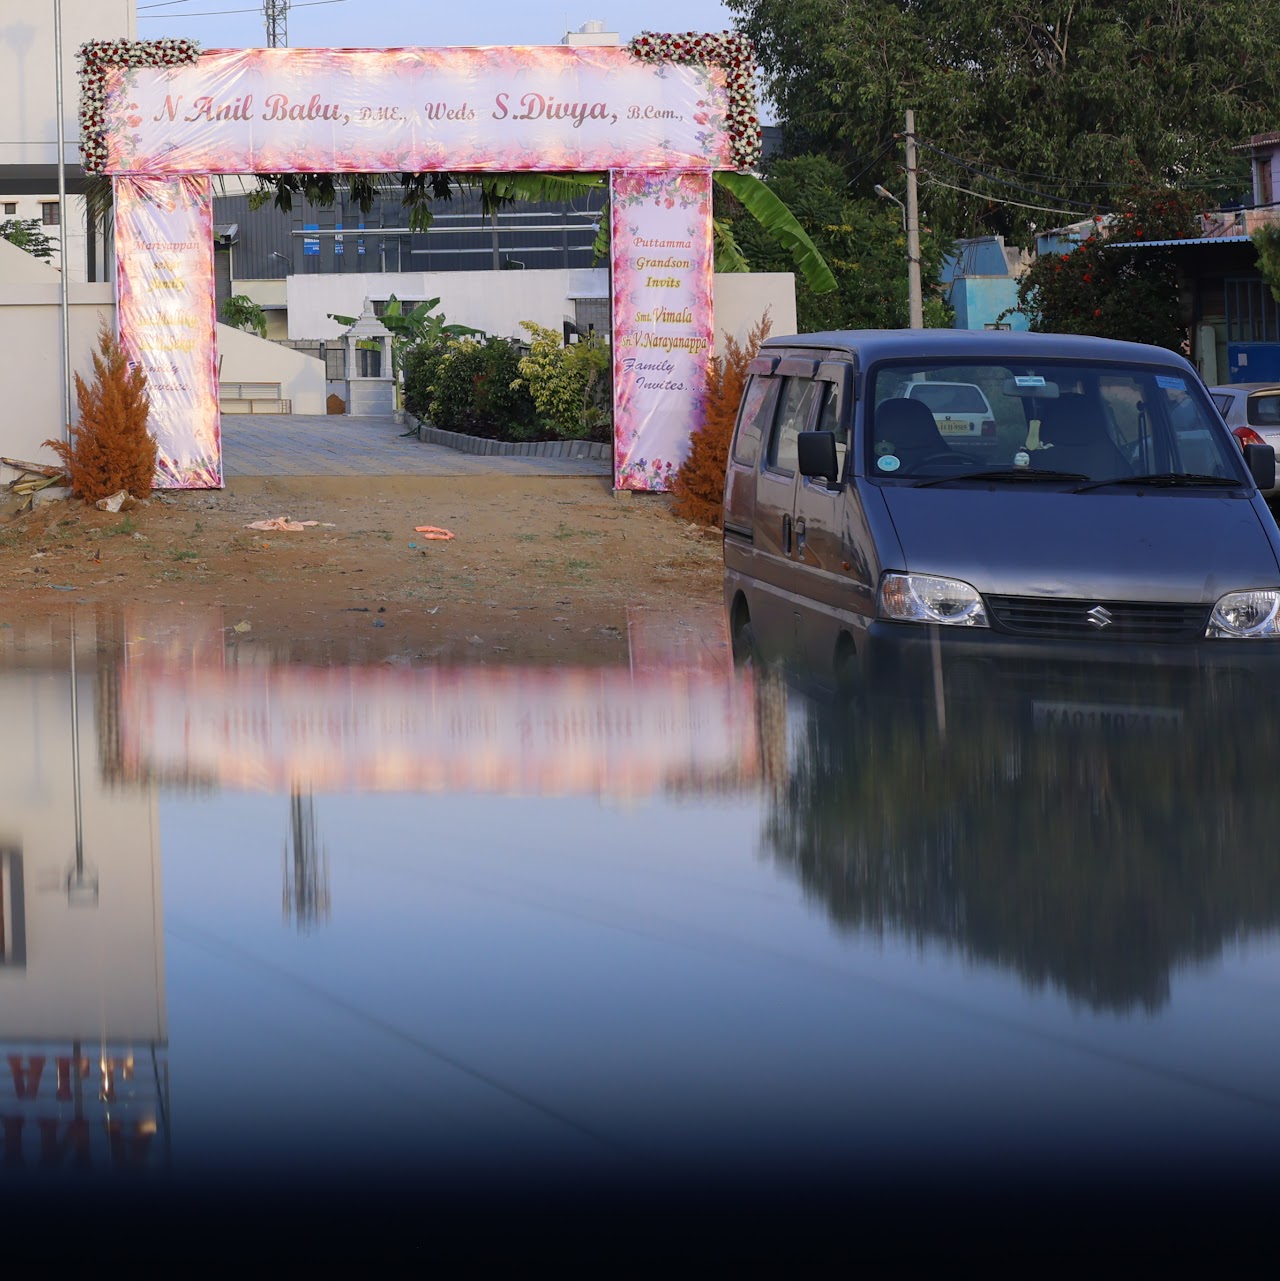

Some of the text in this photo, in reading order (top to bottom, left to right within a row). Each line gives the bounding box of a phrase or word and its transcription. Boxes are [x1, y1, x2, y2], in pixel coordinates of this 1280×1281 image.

[184, 94, 253, 122] Anil
[262, 93, 350, 127] Babu,
[425, 102, 475, 121] Weds
[492, 92, 618, 129] S.Divya,
[633, 237, 692, 249] Puttamma
[636, 257, 690, 270] Grandson
[645, 276, 681, 288] Invits
[653, 306, 692, 324] Vimala
[622, 357, 676, 373] Family
